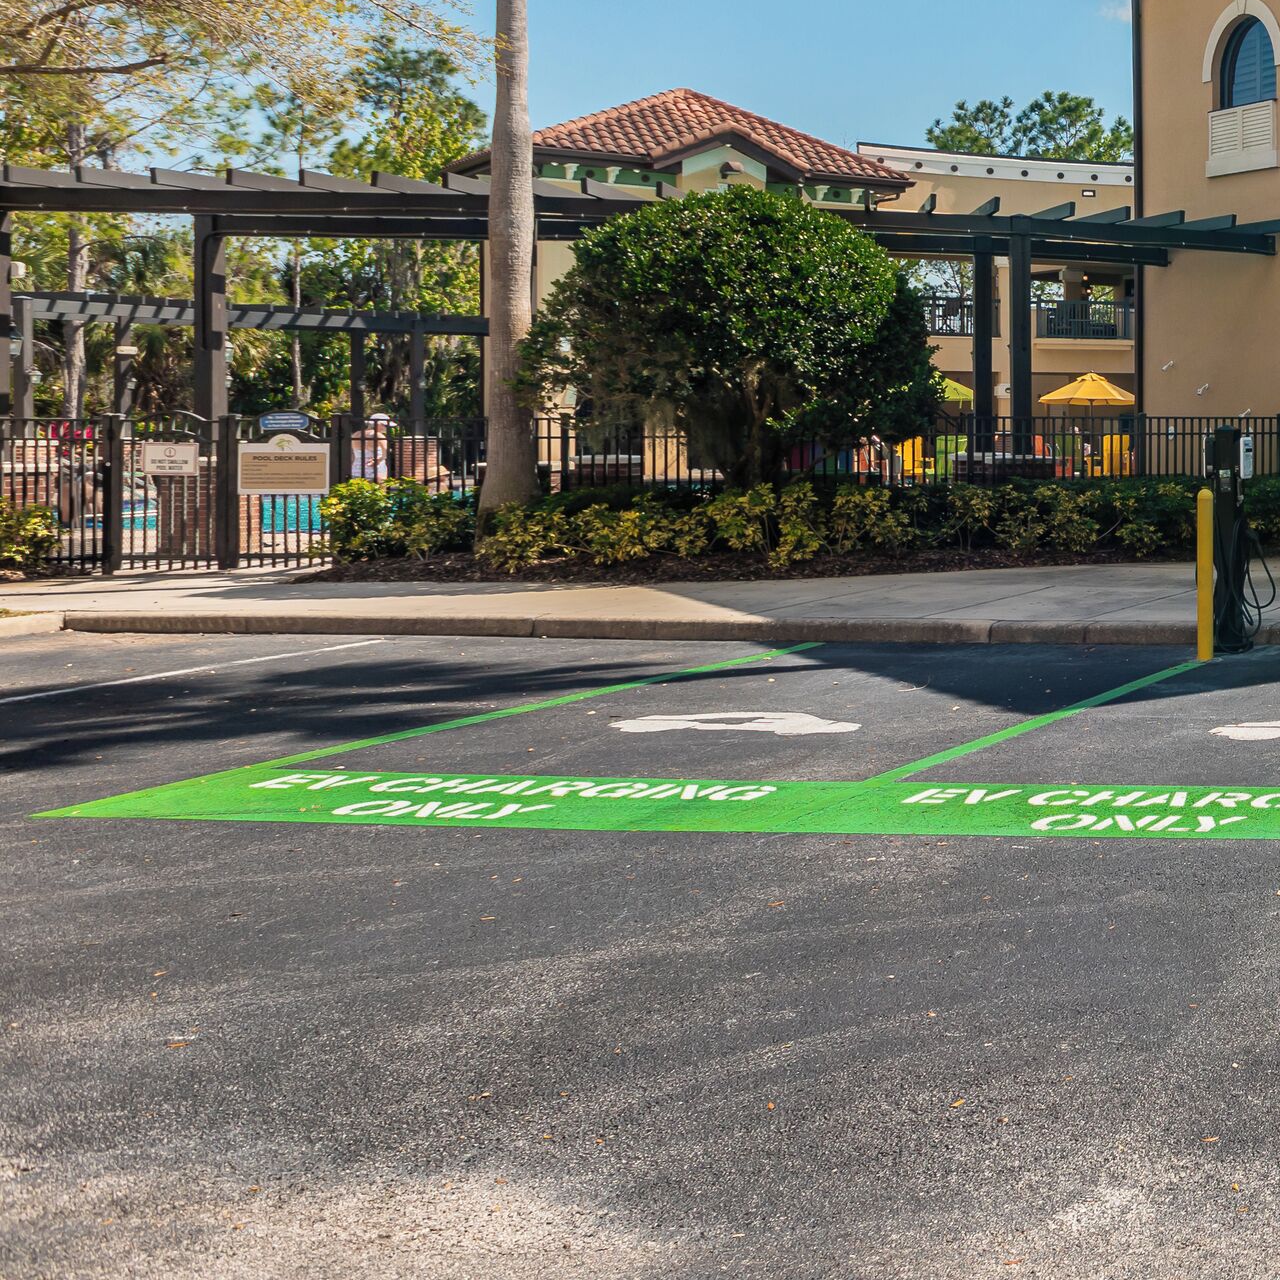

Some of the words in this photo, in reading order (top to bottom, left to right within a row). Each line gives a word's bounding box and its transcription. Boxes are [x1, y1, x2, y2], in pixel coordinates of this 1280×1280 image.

[250, 774, 378, 791] EV
[373, 777, 777, 803] CHARGING
[902, 789, 1022, 805] EV
[332, 799, 554, 819] ONLY
[1031, 814, 1247, 832] ONLY
